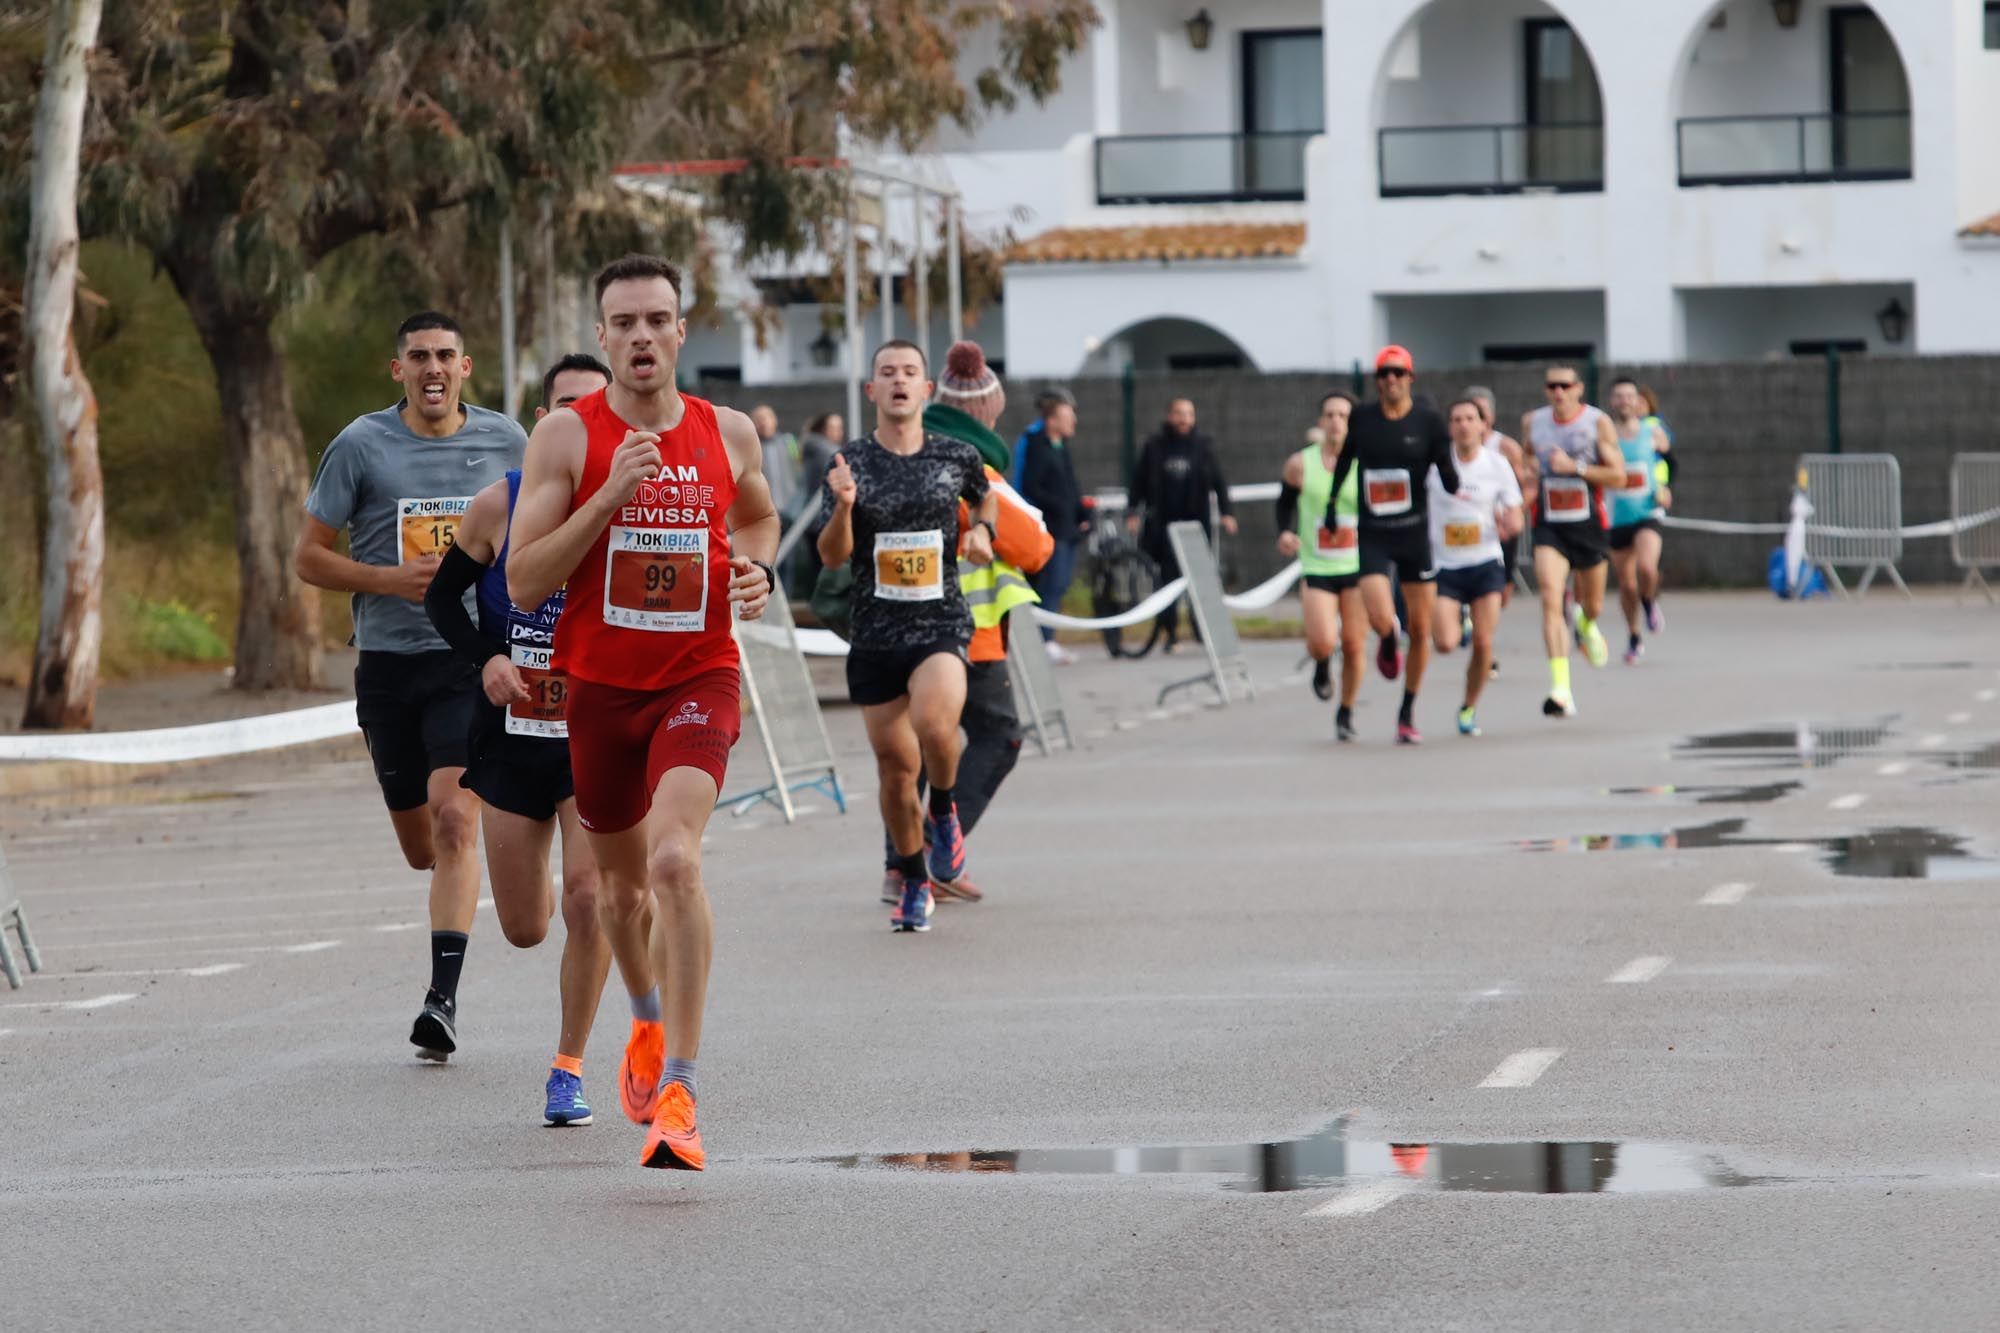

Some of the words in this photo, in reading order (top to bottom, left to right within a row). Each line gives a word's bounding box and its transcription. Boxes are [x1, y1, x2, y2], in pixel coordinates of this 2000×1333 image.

[643, 465, 699, 482] AM
[621, 506, 709, 524] EIVISSA
[430, 525, 454, 547] 15
[645, 564, 676, 592] 99
[533, 651, 553, 664] 10
[537, 679, 568, 704] 19
